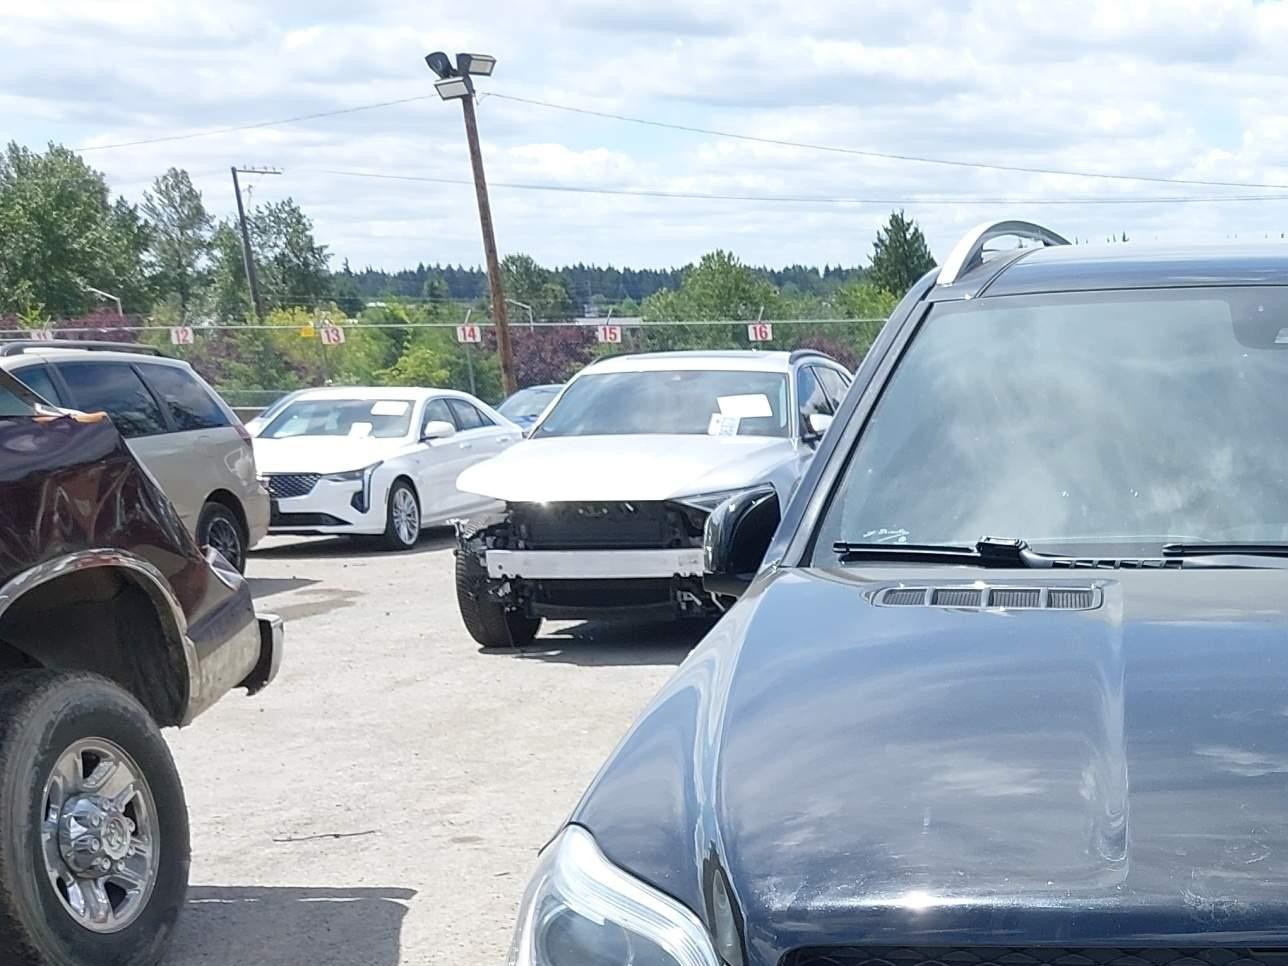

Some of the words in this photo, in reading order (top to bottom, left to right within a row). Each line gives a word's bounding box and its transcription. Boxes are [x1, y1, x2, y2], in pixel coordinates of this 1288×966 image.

[175, 329, 190, 344] 12
[325, 328, 341, 343] 13
[462, 327, 476, 341] 14
[602, 326, 617, 341] 15
[753, 324, 769, 340] 16
